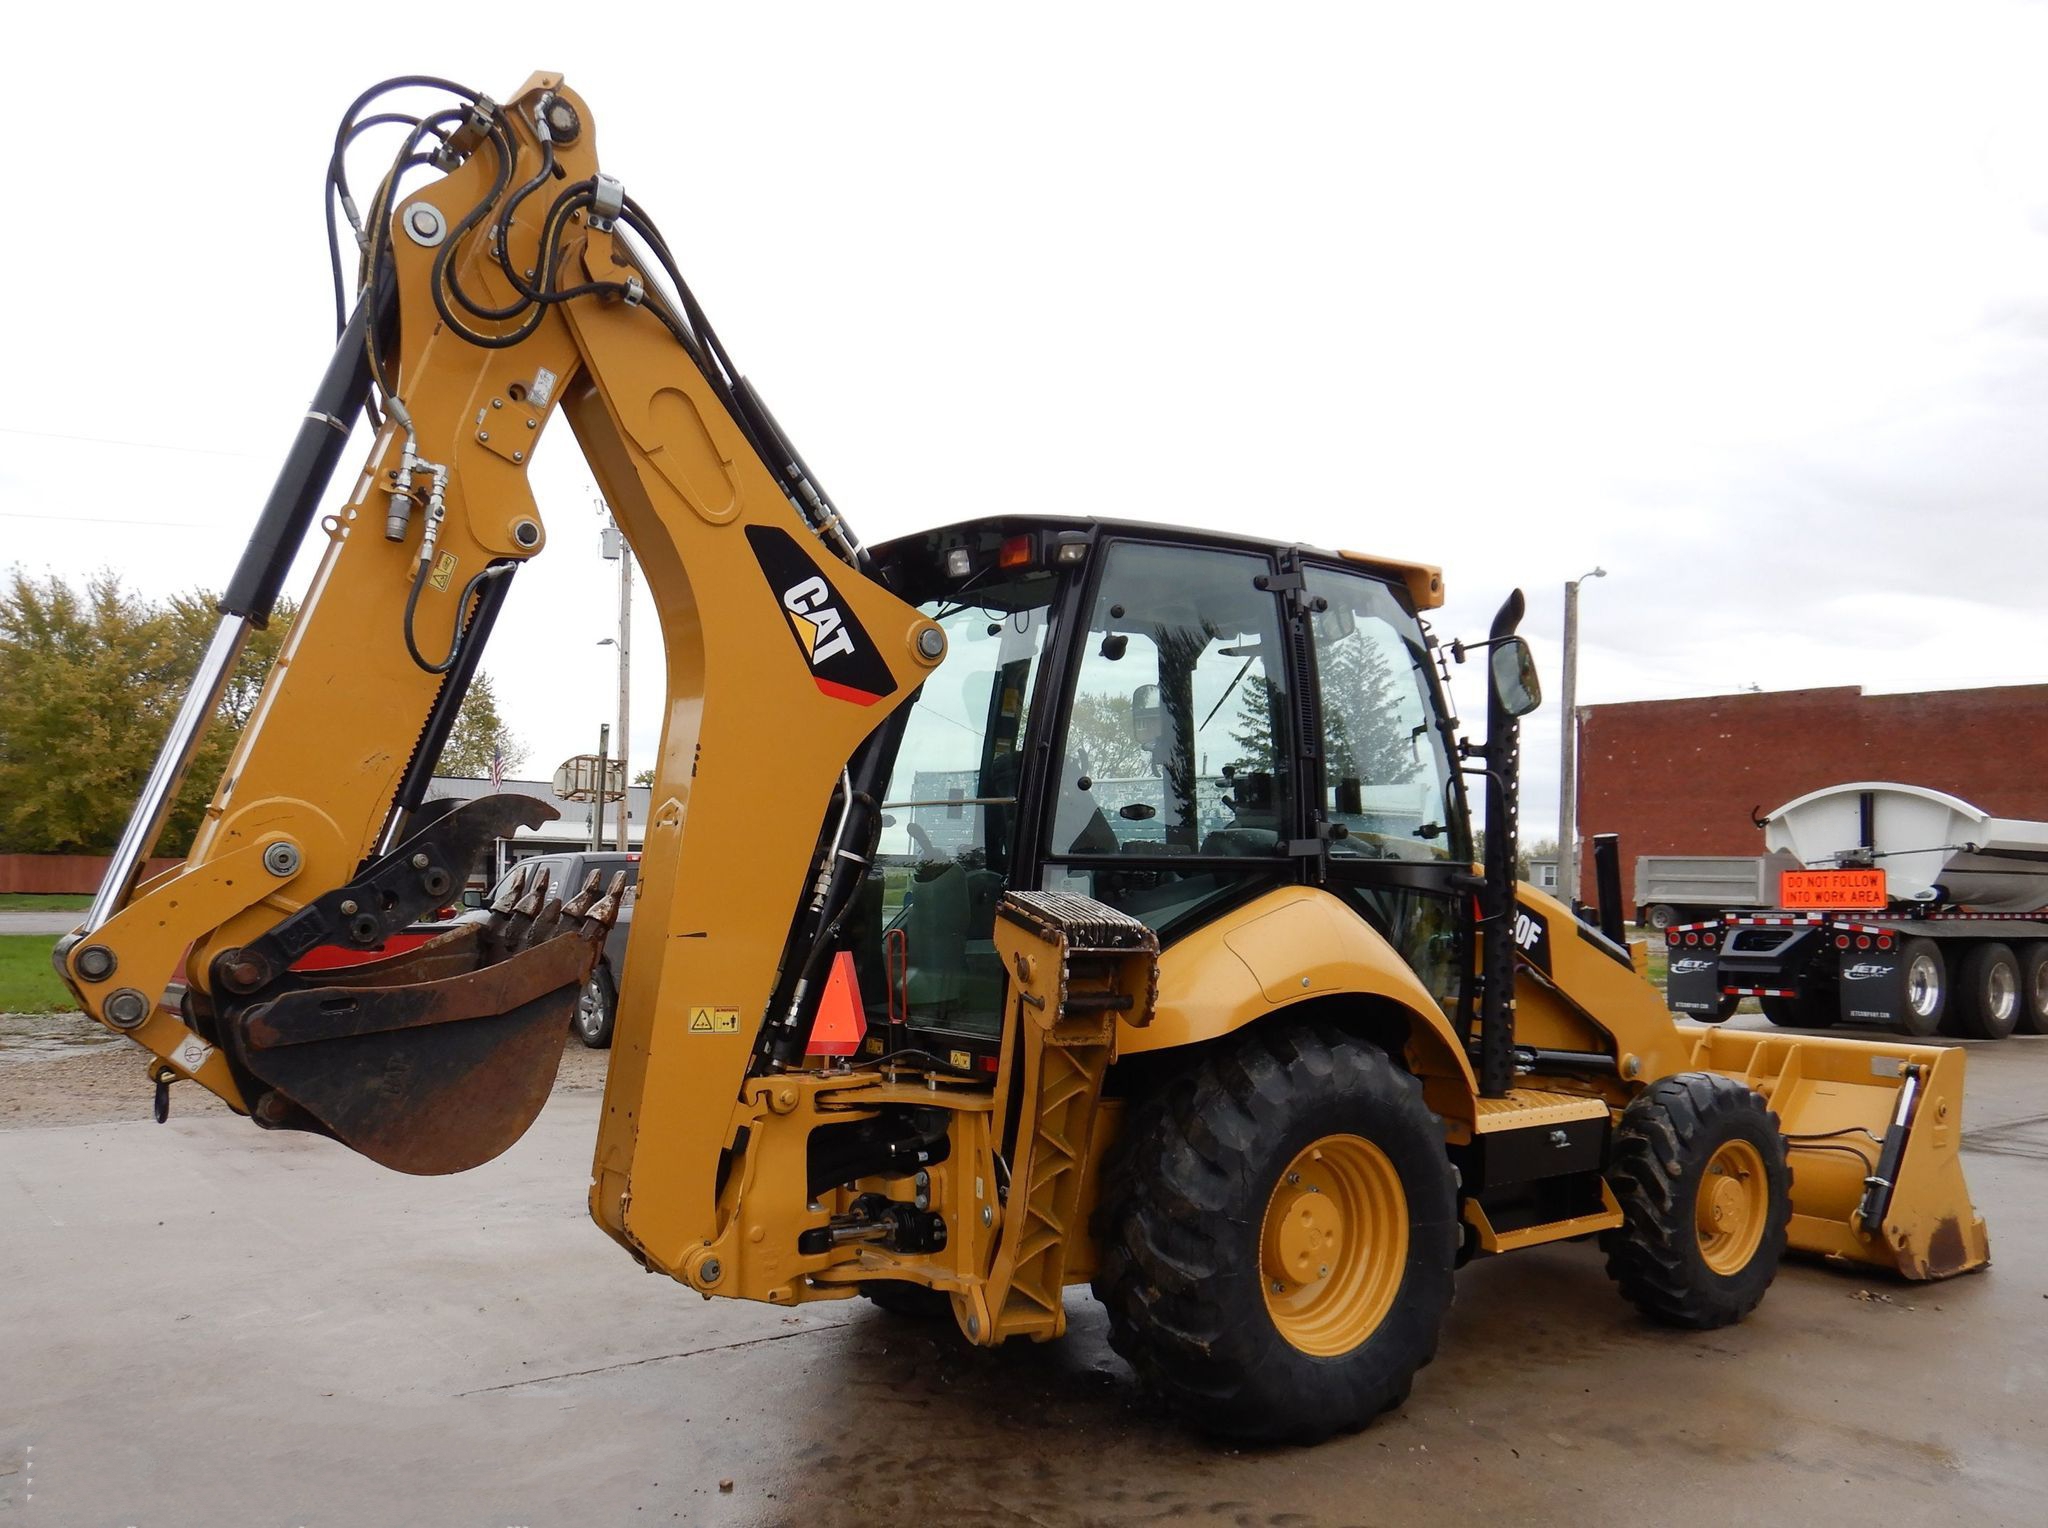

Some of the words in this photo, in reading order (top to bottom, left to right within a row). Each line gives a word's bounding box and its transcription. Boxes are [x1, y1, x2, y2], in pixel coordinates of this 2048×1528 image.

[784, 576, 855, 665] CAT
[1788, 876, 1803, 888] DO
[1807, 876, 1829, 888] NOT
[1833, 875, 1878, 888] FOLLOW
[1786, 891, 1810, 903] INTO
[1815, 891, 1845, 903] WORK
[1851, 891, 1881, 903] AREA
[1514, 909, 1542, 950] 0F
